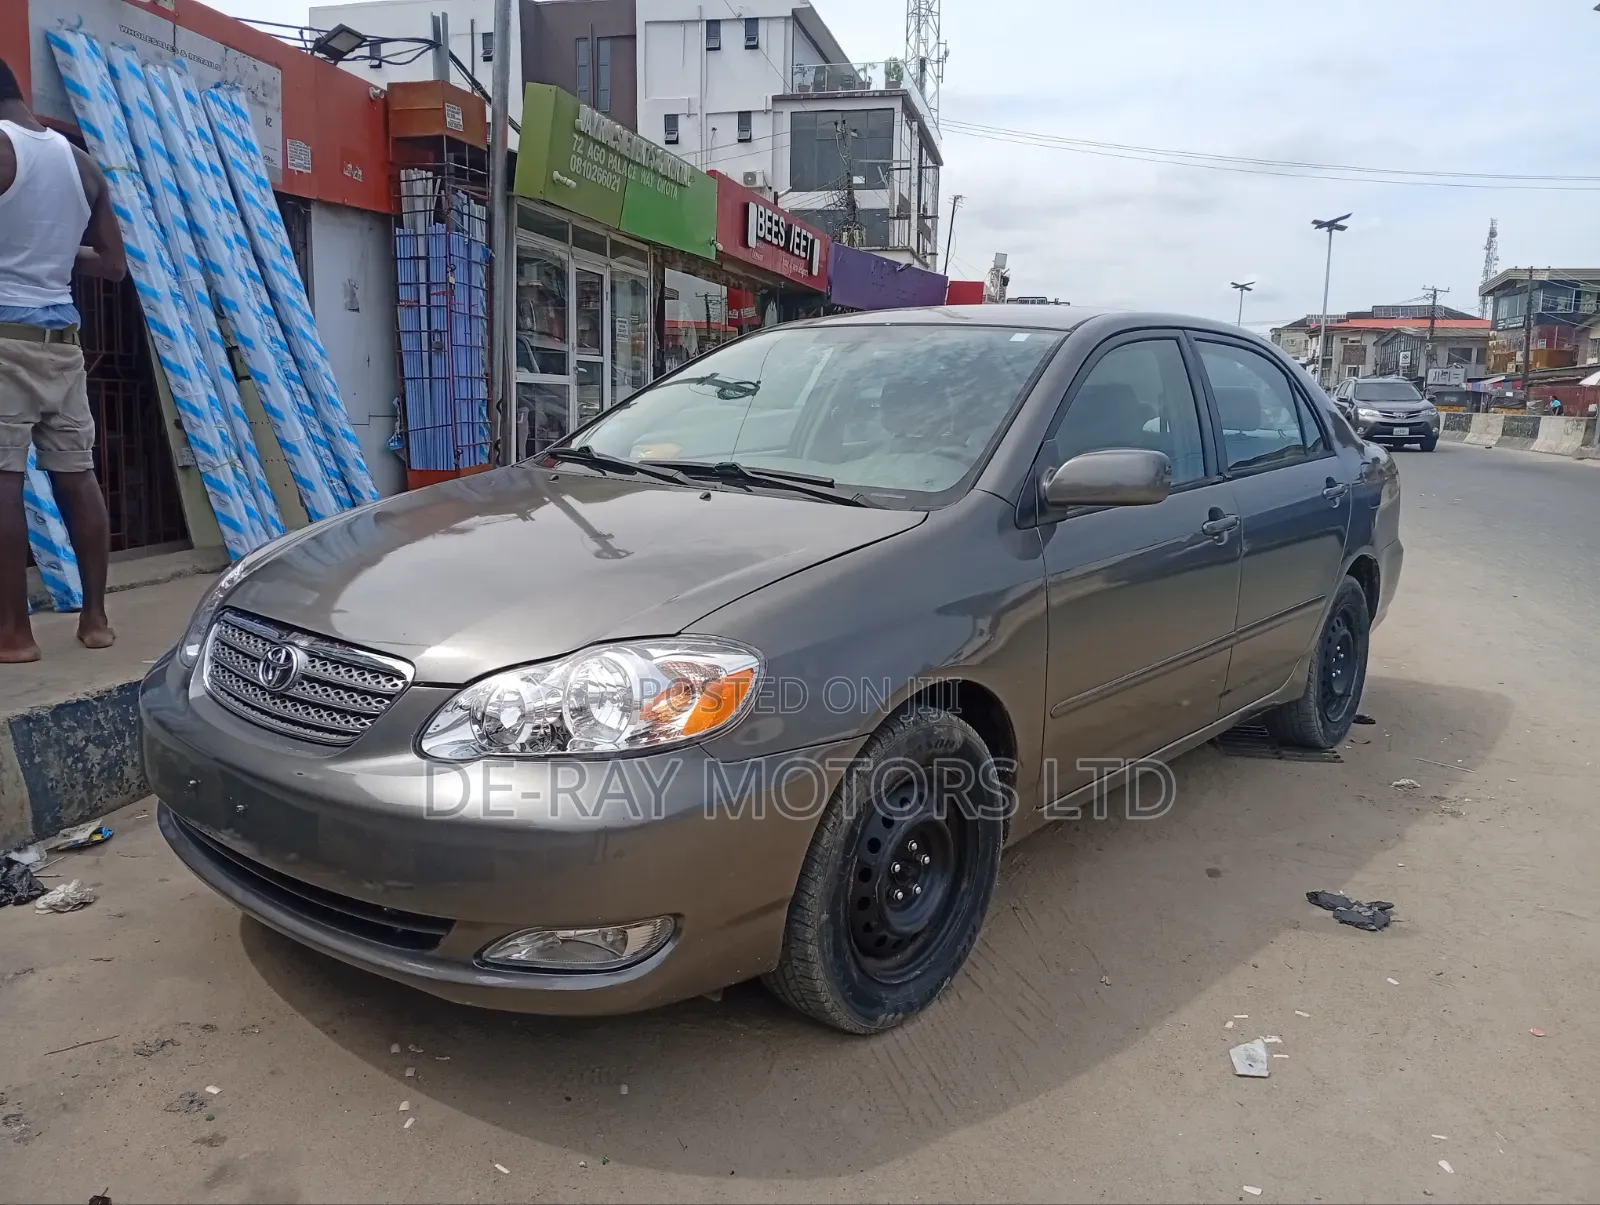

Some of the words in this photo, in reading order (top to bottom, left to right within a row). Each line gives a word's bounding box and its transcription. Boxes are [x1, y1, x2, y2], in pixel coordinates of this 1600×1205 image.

[119, 24, 179, 54] WHOLESALES
[180, 49, 188, 57] &
[188, 52, 222, 71] RETAILS
[572, 133, 584, 155] 72
[587, 143, 606, 165] AGO
[608, 154, 637, 180] PALACE
[640, 168, 655, 188] WAY
[656, 177, 678, 200] OKOTA
[757, 204, 786, 248] BEES
